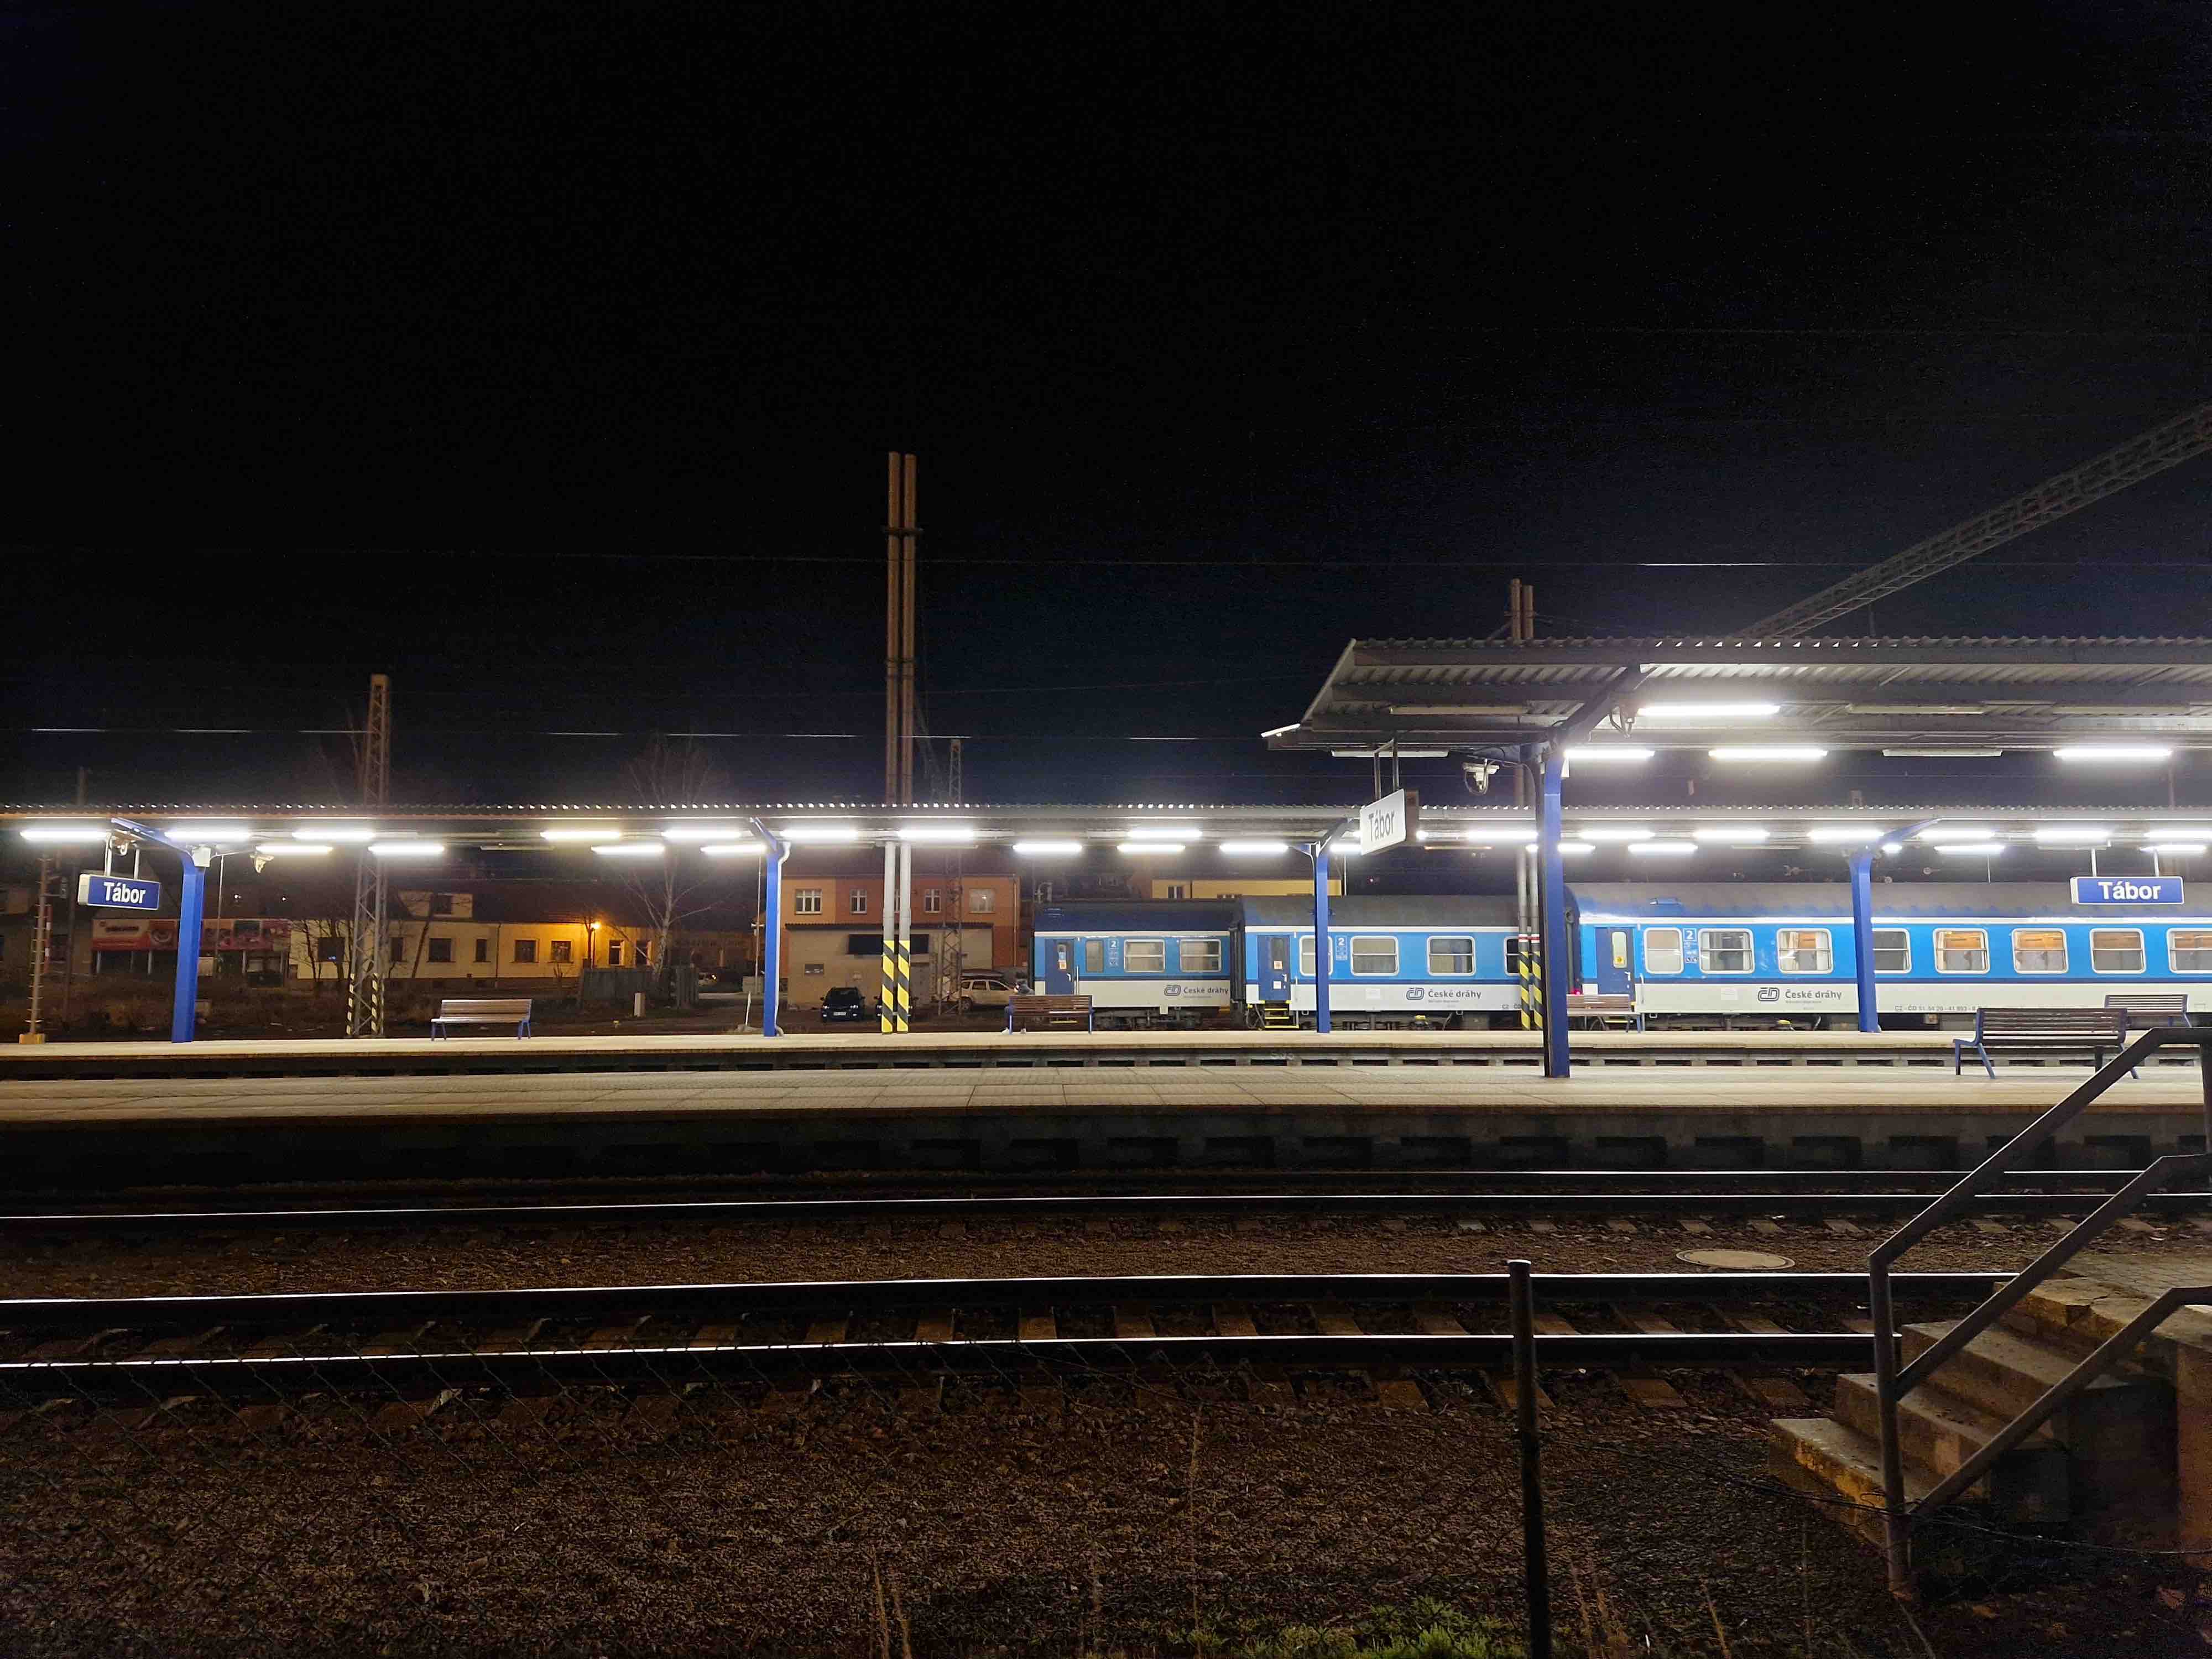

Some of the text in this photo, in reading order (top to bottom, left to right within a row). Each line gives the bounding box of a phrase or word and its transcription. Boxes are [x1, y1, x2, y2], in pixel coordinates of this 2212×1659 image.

[1369, 809, 1395, 842] Tábor
[103, 882, 146, 904] Tábor
[2098, 880, 2161, 900] Tábor
[1686, 930, 1693, 939] 2
[1338, 937, 1345, 946] 2
[1428, 988, 1454, 997] České
[1455, 990, 1481, 999] dráhy
[1785, 989, 1812, 998] České
[1815, 990, 1841, 999] dráhy
